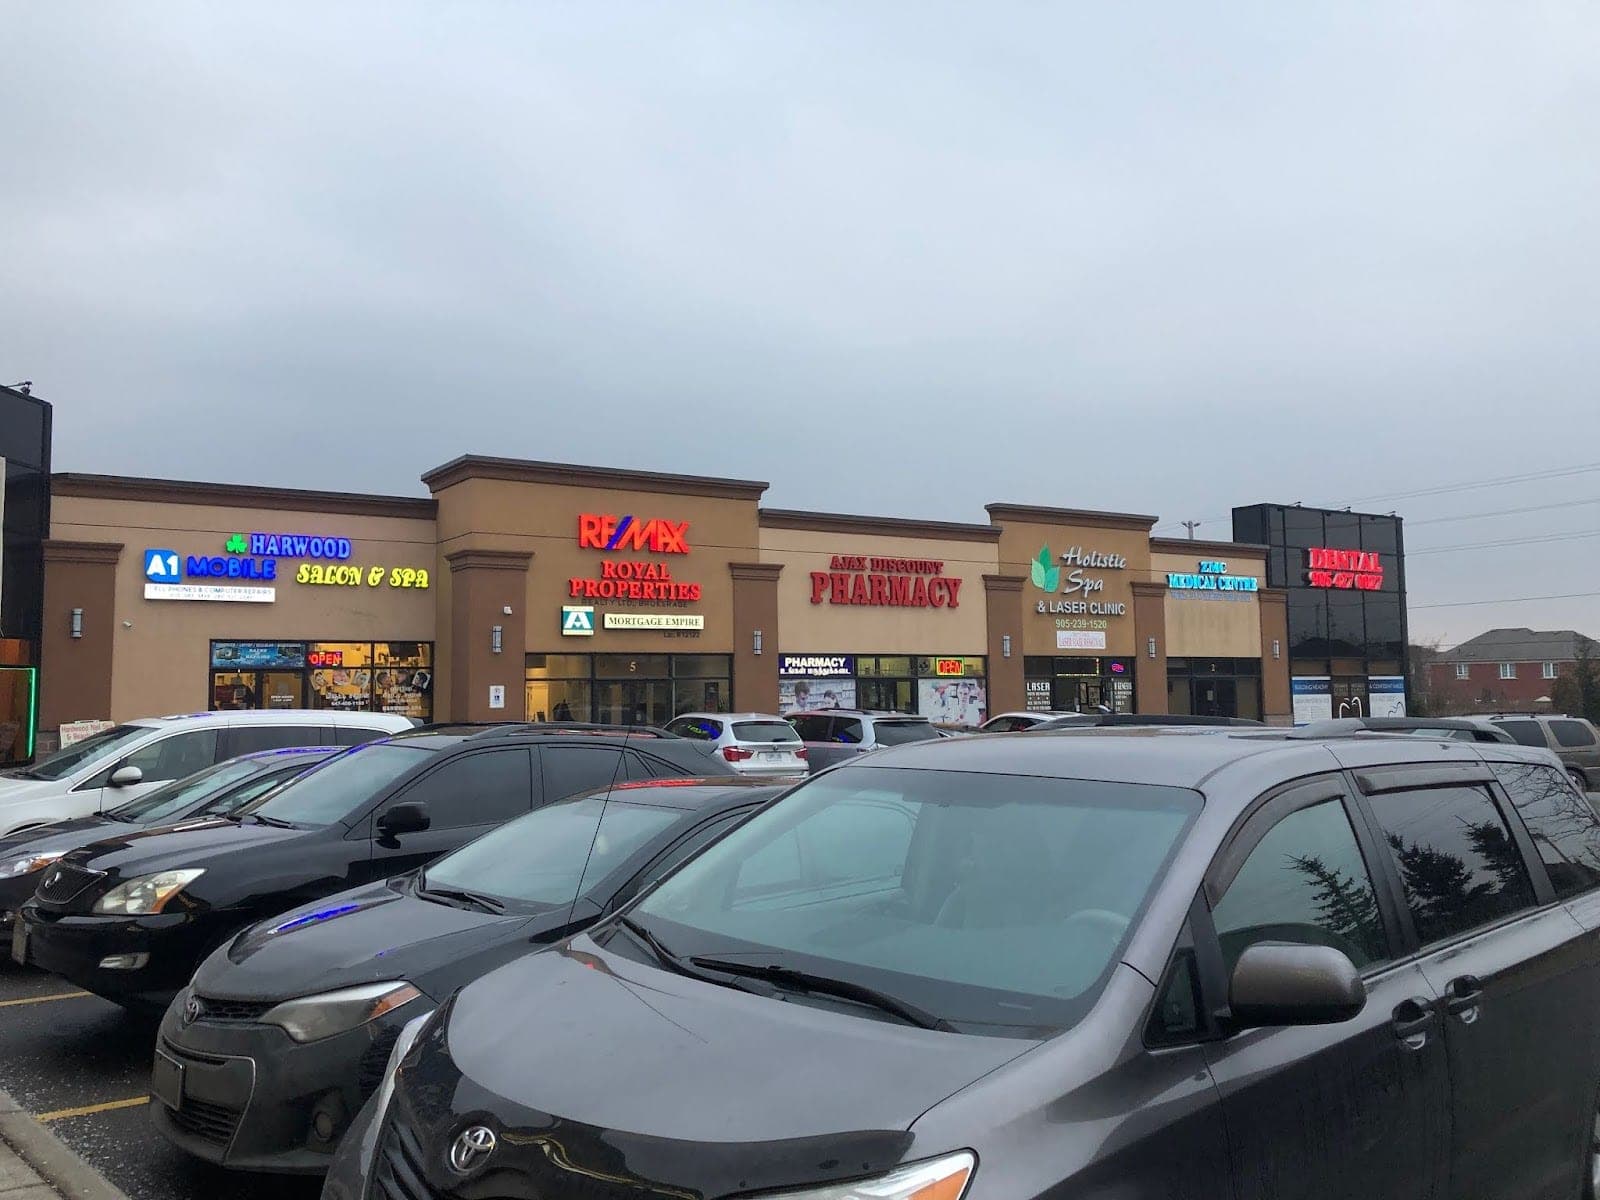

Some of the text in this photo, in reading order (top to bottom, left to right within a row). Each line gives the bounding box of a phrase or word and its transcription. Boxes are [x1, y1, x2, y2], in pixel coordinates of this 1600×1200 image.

[578, 513, 689, 554] RE/MAX
[251, 533, 351, 559] HARWOOD
[146, 554, 276, 580] A1 MOBILE
[830, 556, 944, 574] AJAX DISCOUNT
[1062, 546, 1127, 569] Holistic
[1308, 547, 1383, 573] DENTAL
[297, 564, 429, 588] SALON & SPA
[601, 560, 672, 580] ROYAL
[568, 577, 703, 601] PROPERTIES
[810, 572, 962, 608] PHARMACY
[1063, 569, 1104, 598] Spa
[1166, 573, 1217, 590] MEDICAL
[1037, 601, 1126, 615] & LASER CLINIC
[608, 616, 701, 627] MORTGAGE EMPIRE
[310, 654, 341, 665] OPEN
[629, 661, 637, 672] 5
[784, 656, 846, 668] PHARMACY
[938, 660, 963, 674] OPEN
[1026, 682, 1051, 691] LASER
